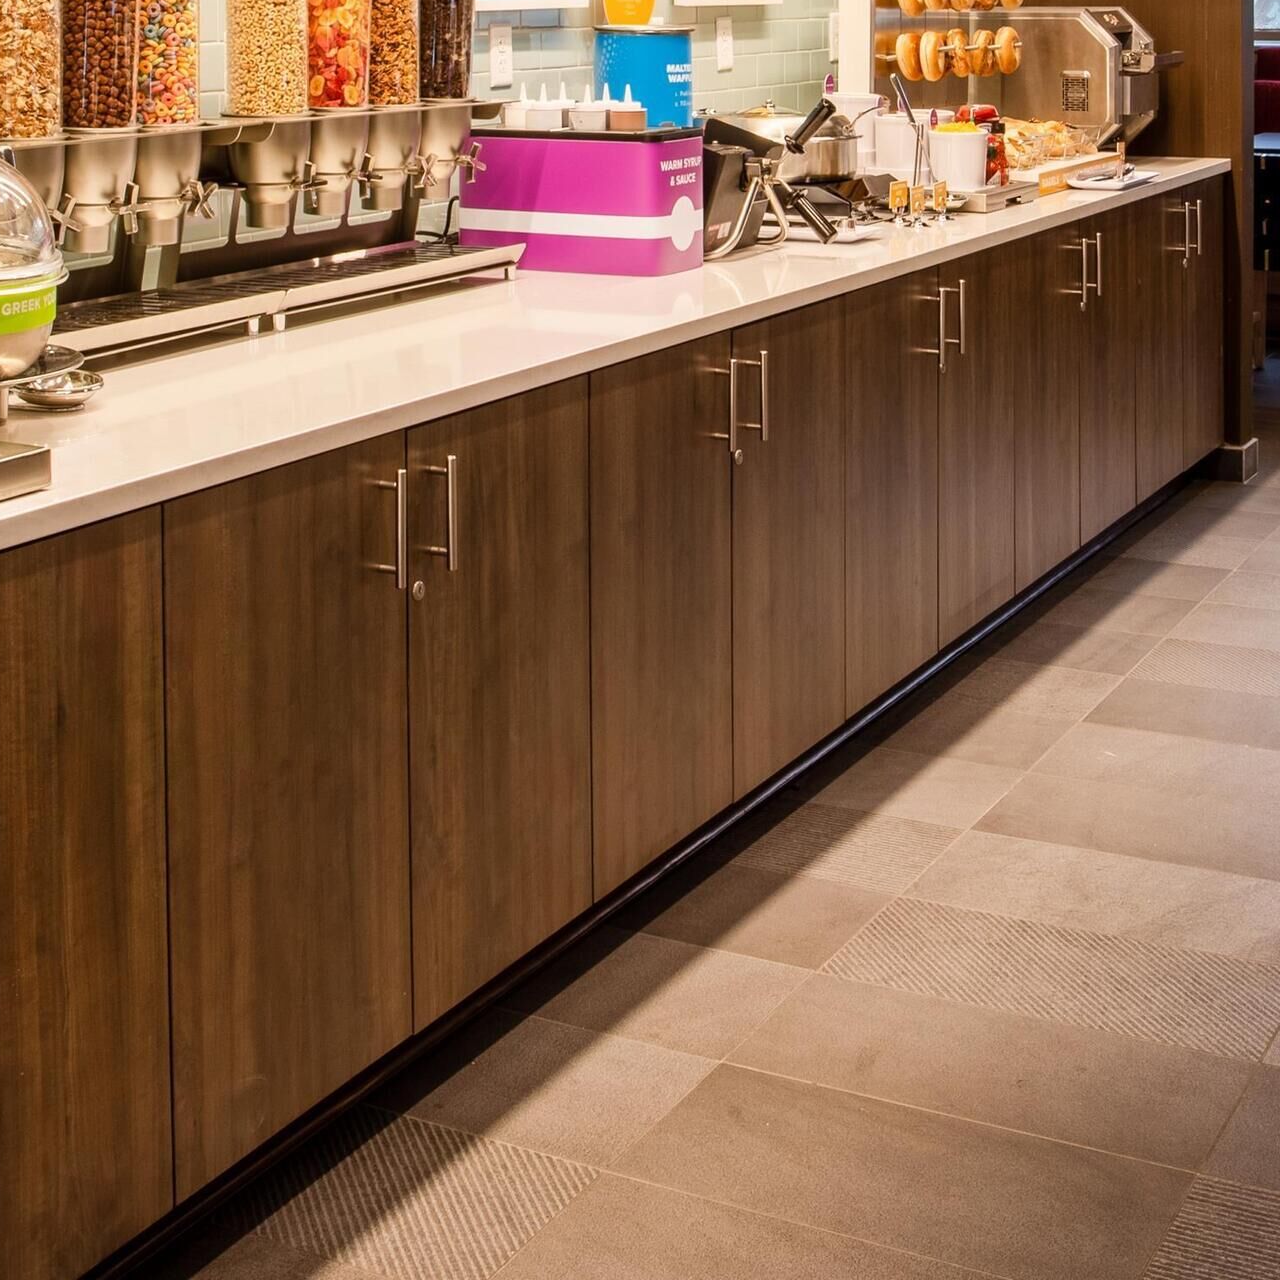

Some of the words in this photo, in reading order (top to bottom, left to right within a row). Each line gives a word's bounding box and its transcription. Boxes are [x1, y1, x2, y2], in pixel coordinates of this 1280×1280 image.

[660, 158, 683, 172] WARM
[683, 155, 702, 169] SYRUP
[670, 175, 675, 186] &
[676, 172, 697, 186] SAUCE
[1, 298, 41, 317] GREEK
